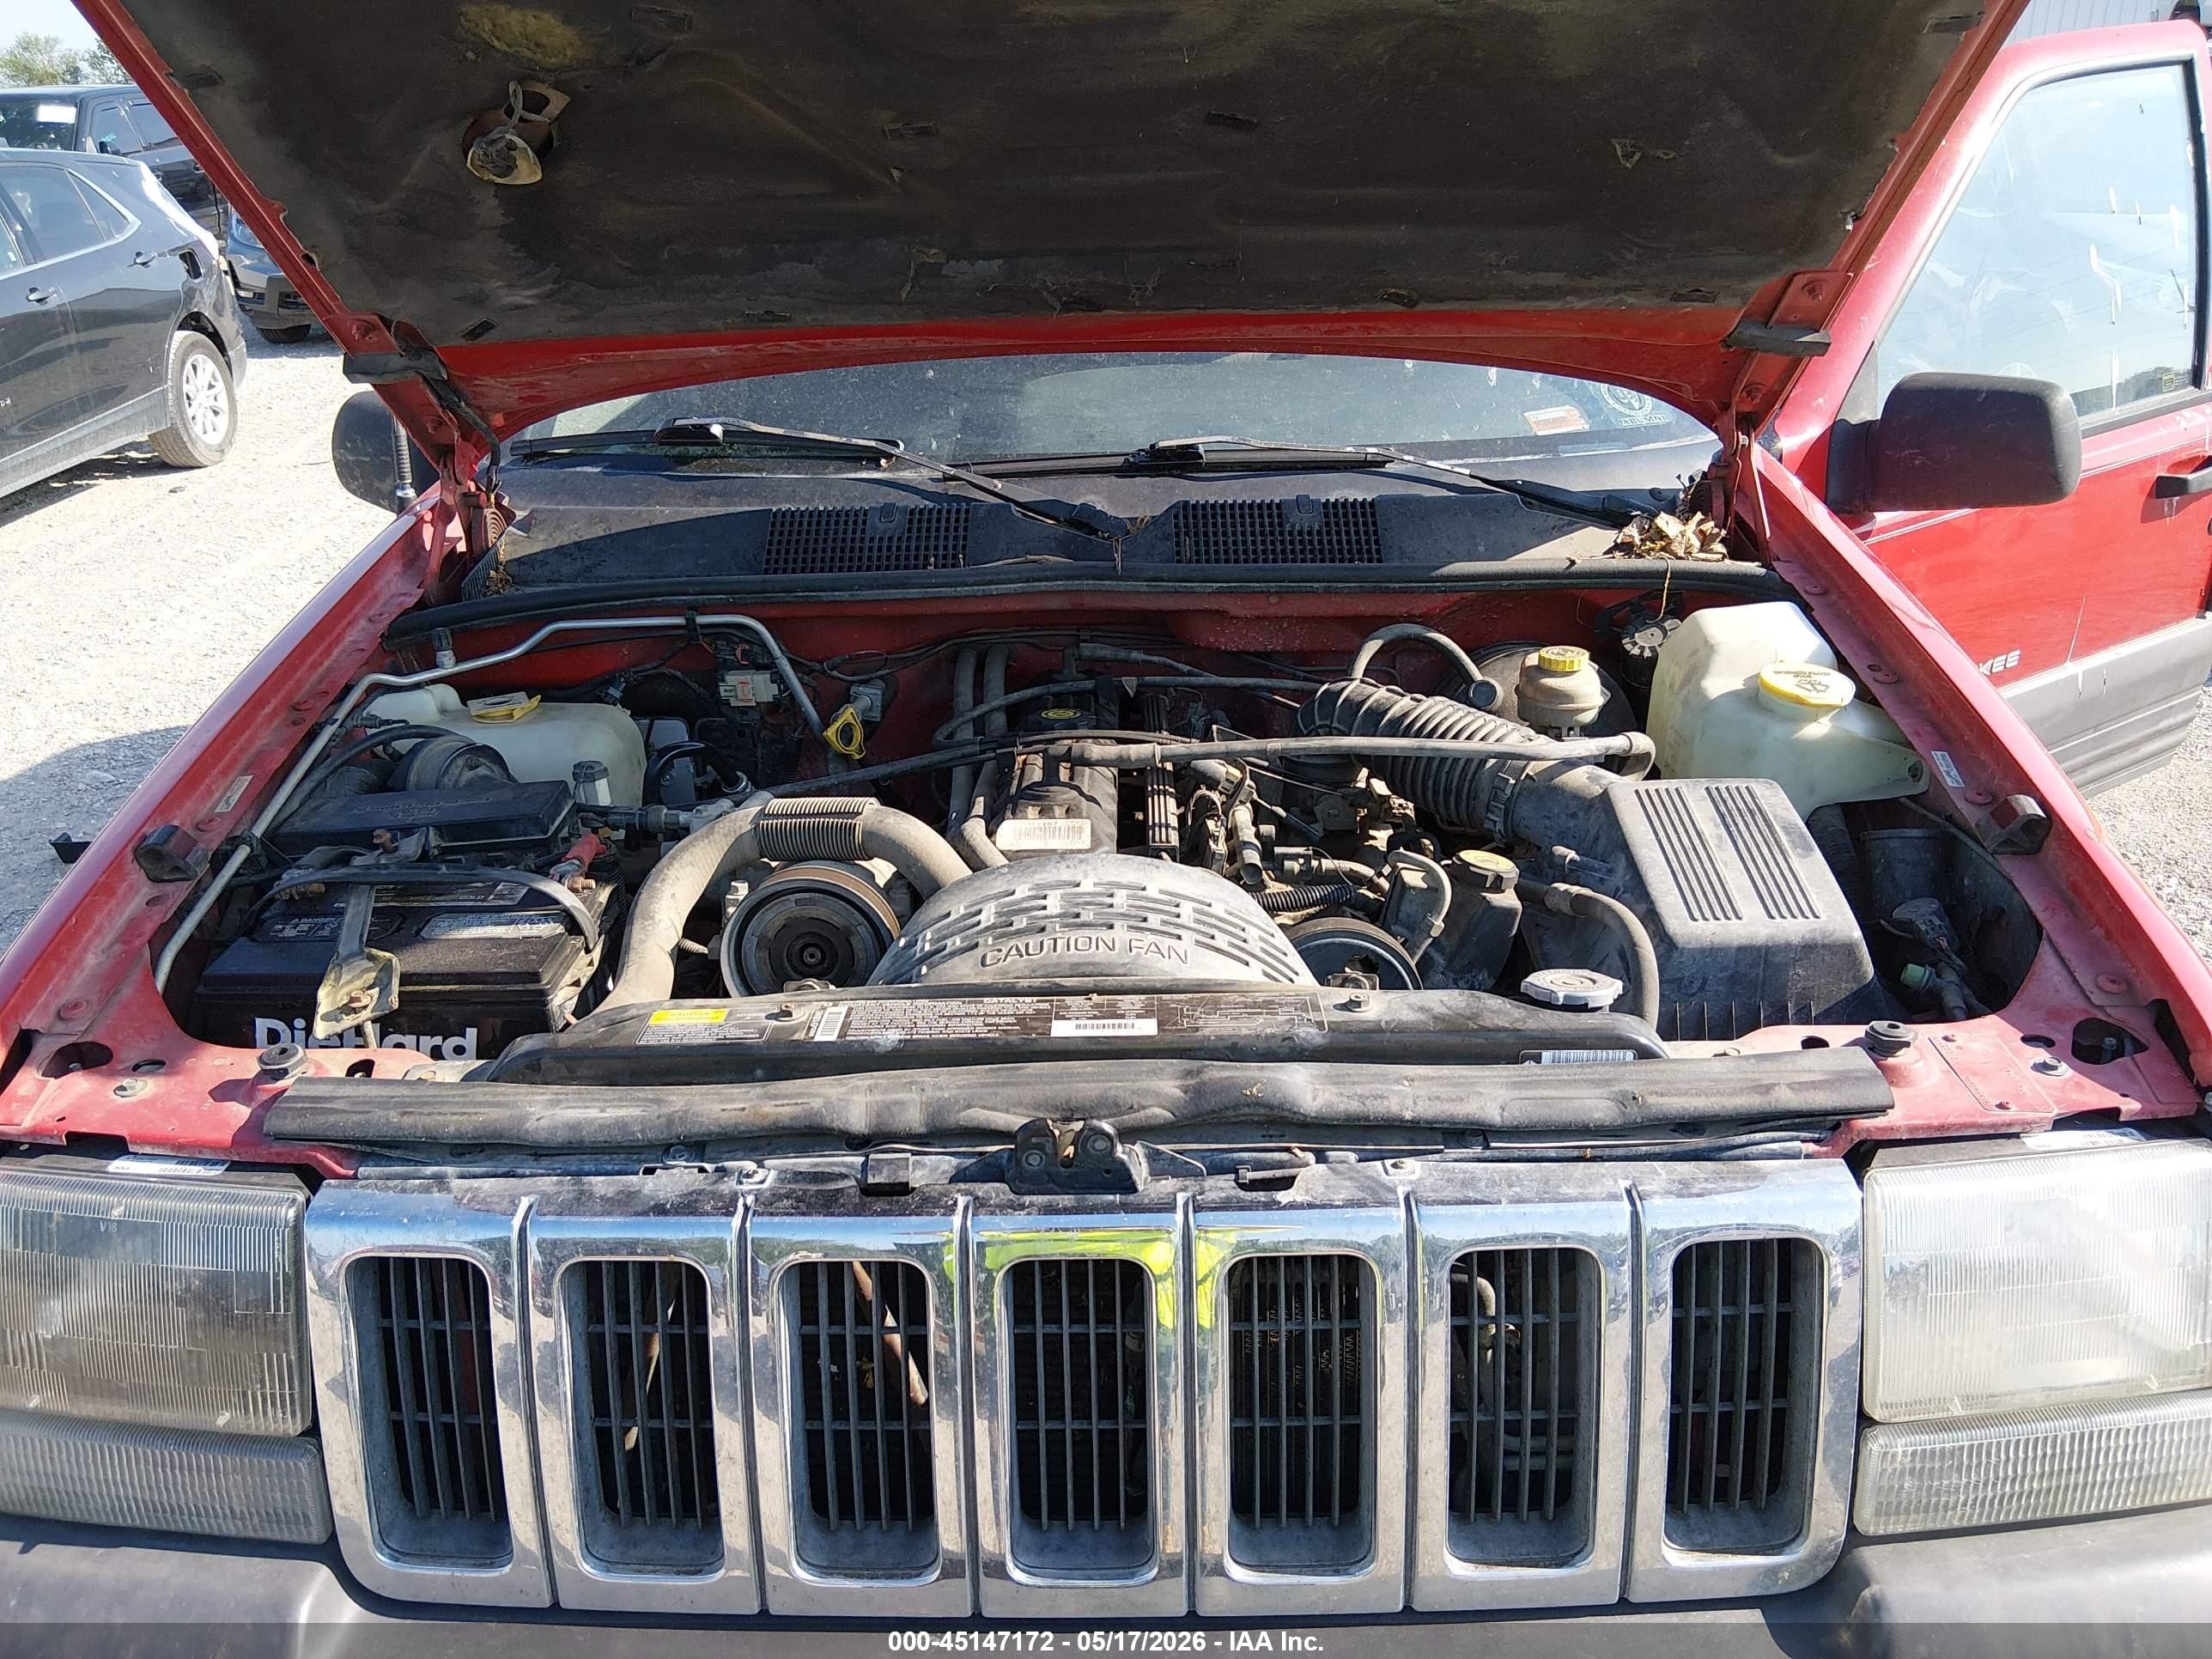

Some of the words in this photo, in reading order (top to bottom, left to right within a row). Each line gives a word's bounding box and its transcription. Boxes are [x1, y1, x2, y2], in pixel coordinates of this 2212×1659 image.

[1622, 416, 1666, 425] ALUMNI
[981, 936, 1115, 968] CAUTION
[1128, 938, 1188, 965] FAN
